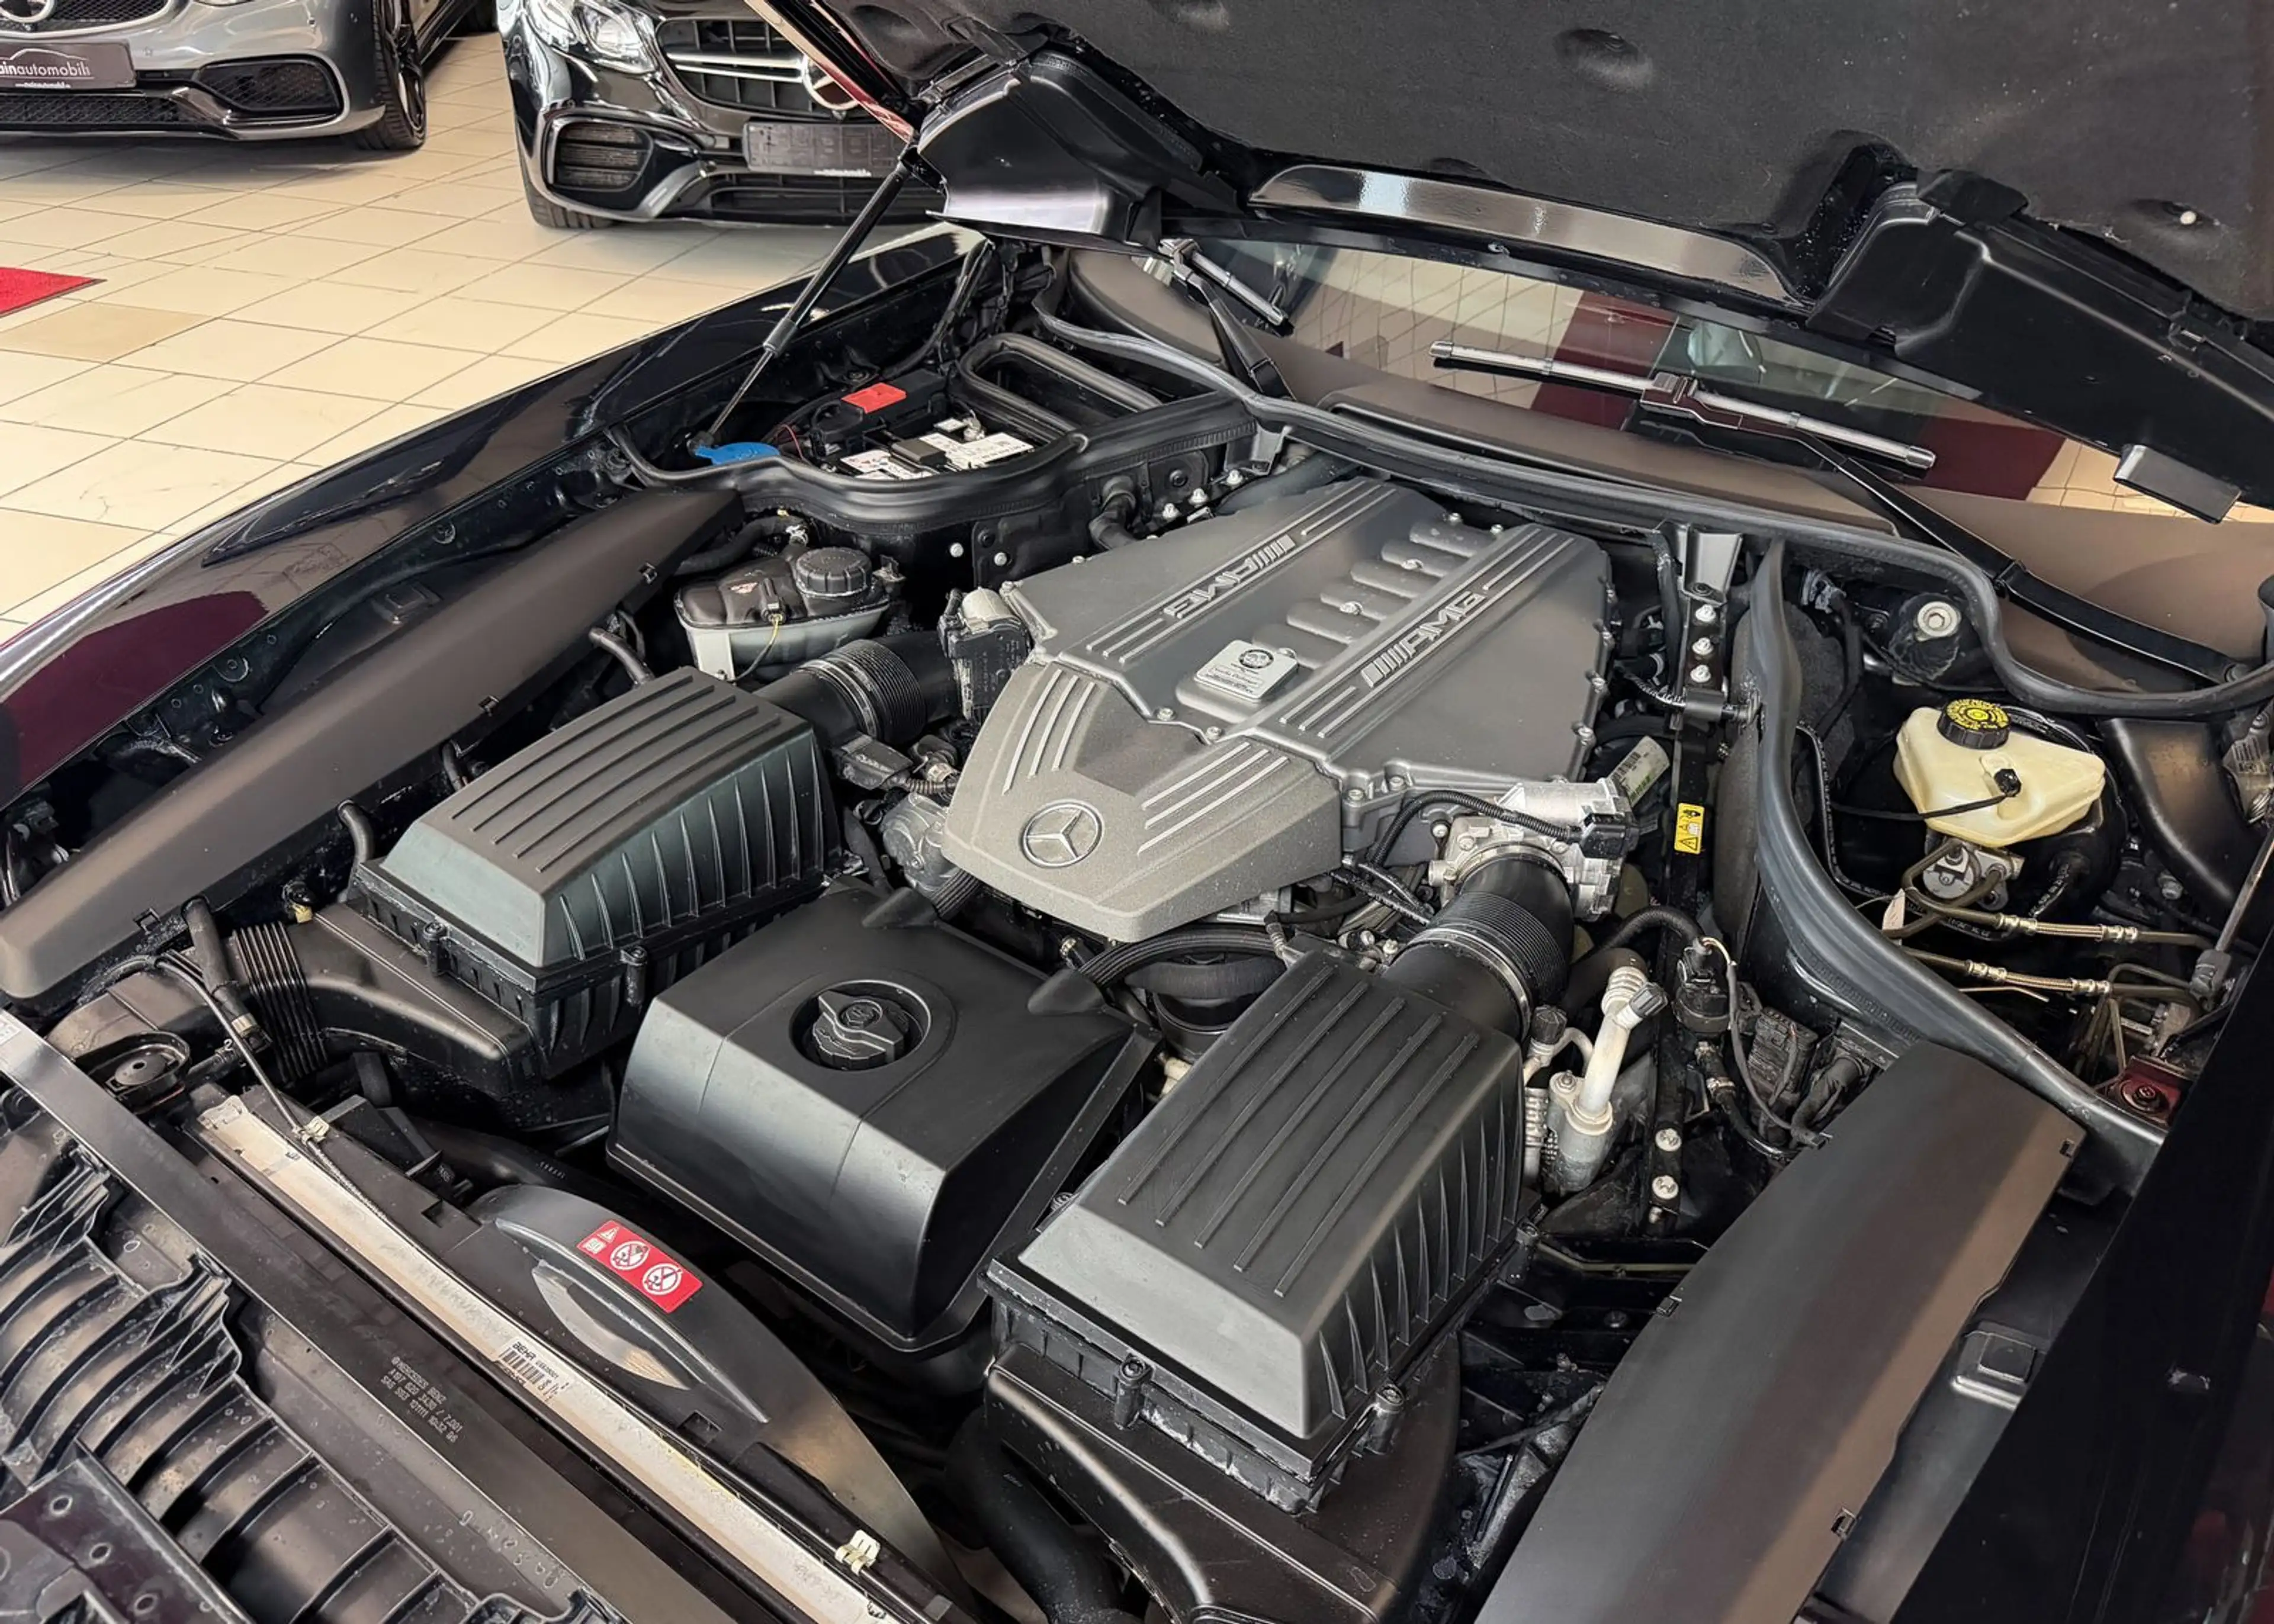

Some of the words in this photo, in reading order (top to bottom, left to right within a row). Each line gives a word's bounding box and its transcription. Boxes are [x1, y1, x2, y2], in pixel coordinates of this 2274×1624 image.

[513, 1341, 537, 1361] BEHR
[396, 1361, 429, 1390] MERCEDES
[427, 1387, 447, 1405] BENZ
